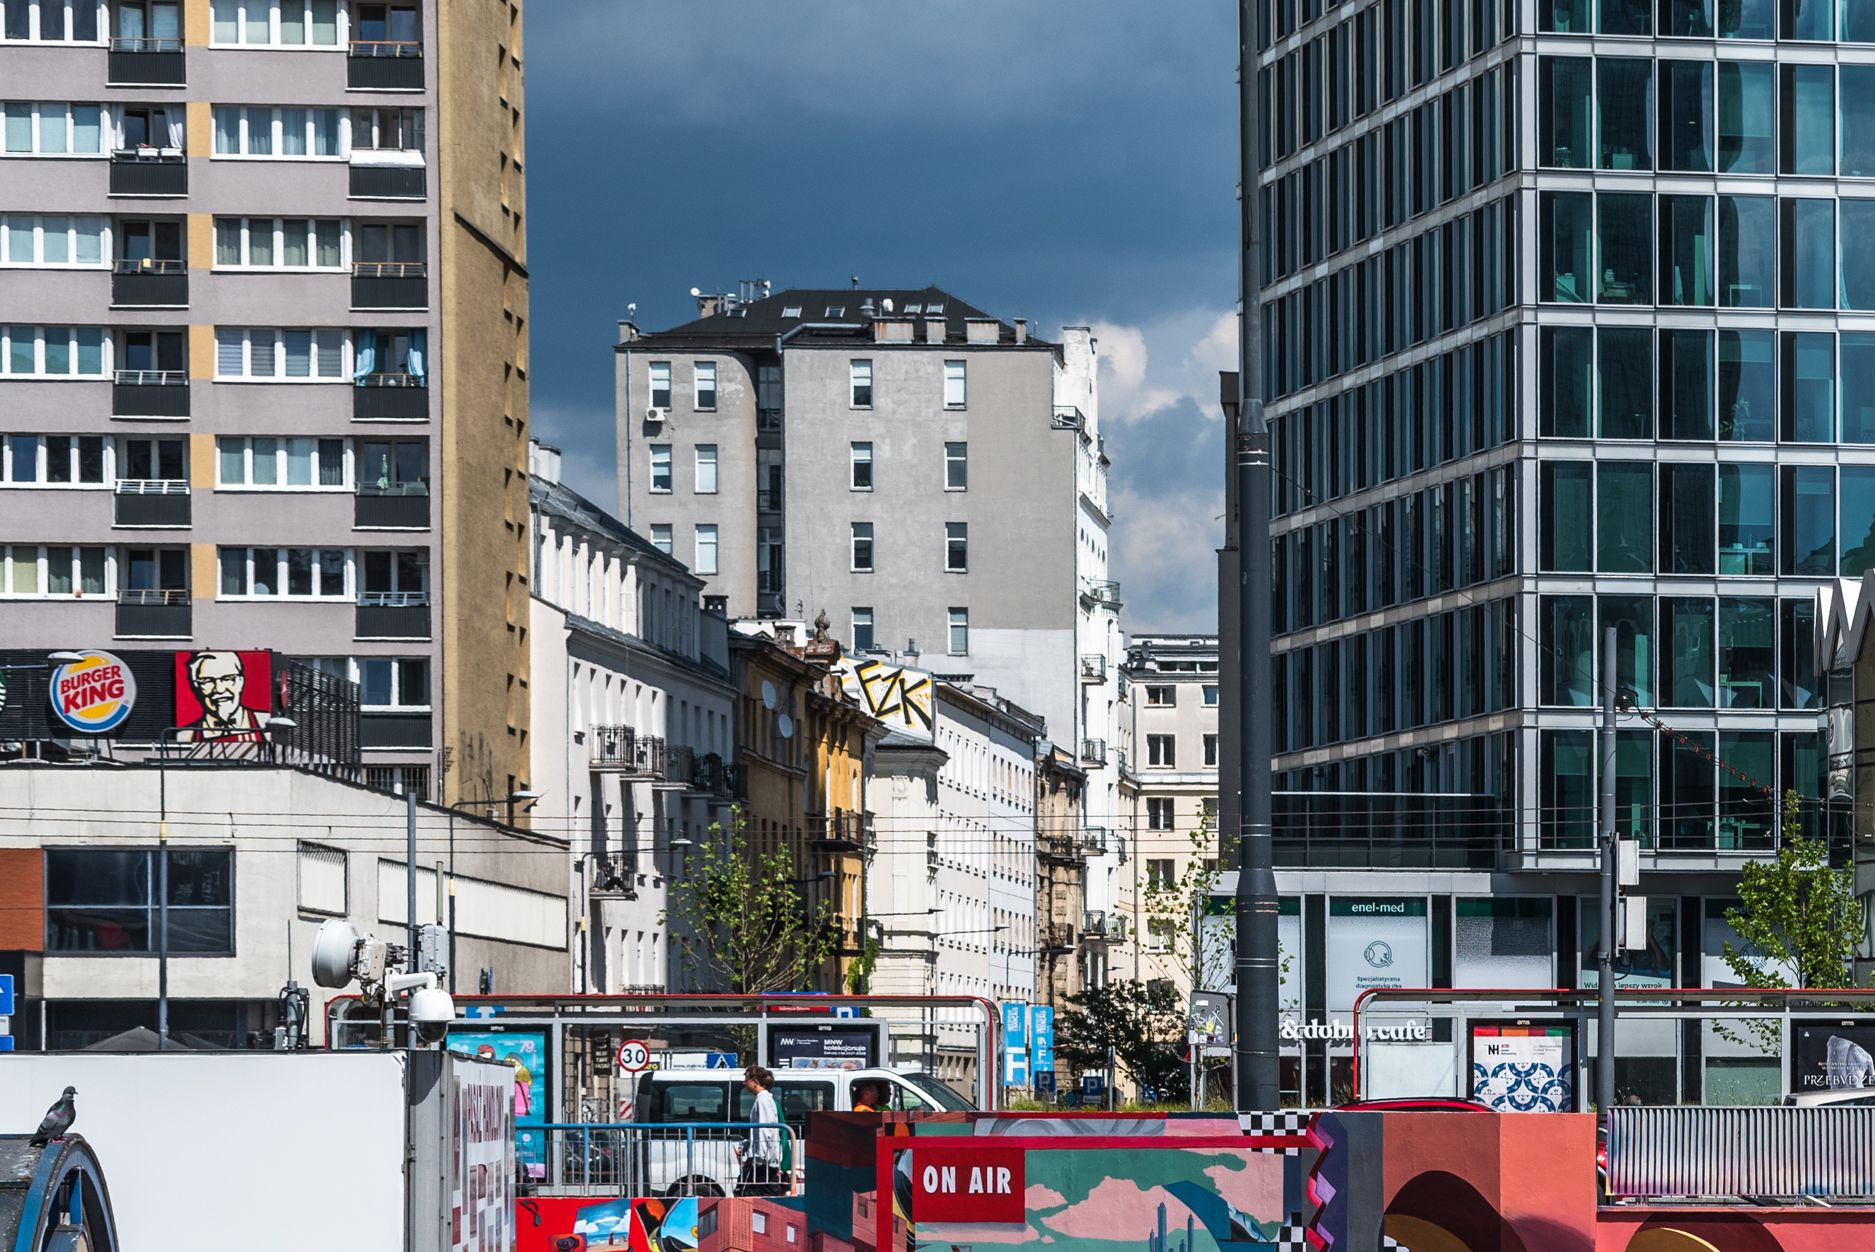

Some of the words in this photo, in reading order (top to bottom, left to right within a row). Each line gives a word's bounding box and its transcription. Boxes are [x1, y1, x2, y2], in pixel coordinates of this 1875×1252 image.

[60, 665, 122, 695] BURGER
[63, 679, 125, 715] KING
[1351, 902, 1405, 913] enel-med
[1281, 1019, 1301, 1039] &
[1377, 1019, 1427, 1040] cafe
[622, 1048, 646, 1064] 30
[1087, 1078, 1098, 1094] P
[922, 1165, 956, 1193] ON
[968, 1166, 1011, 1194] AIR
